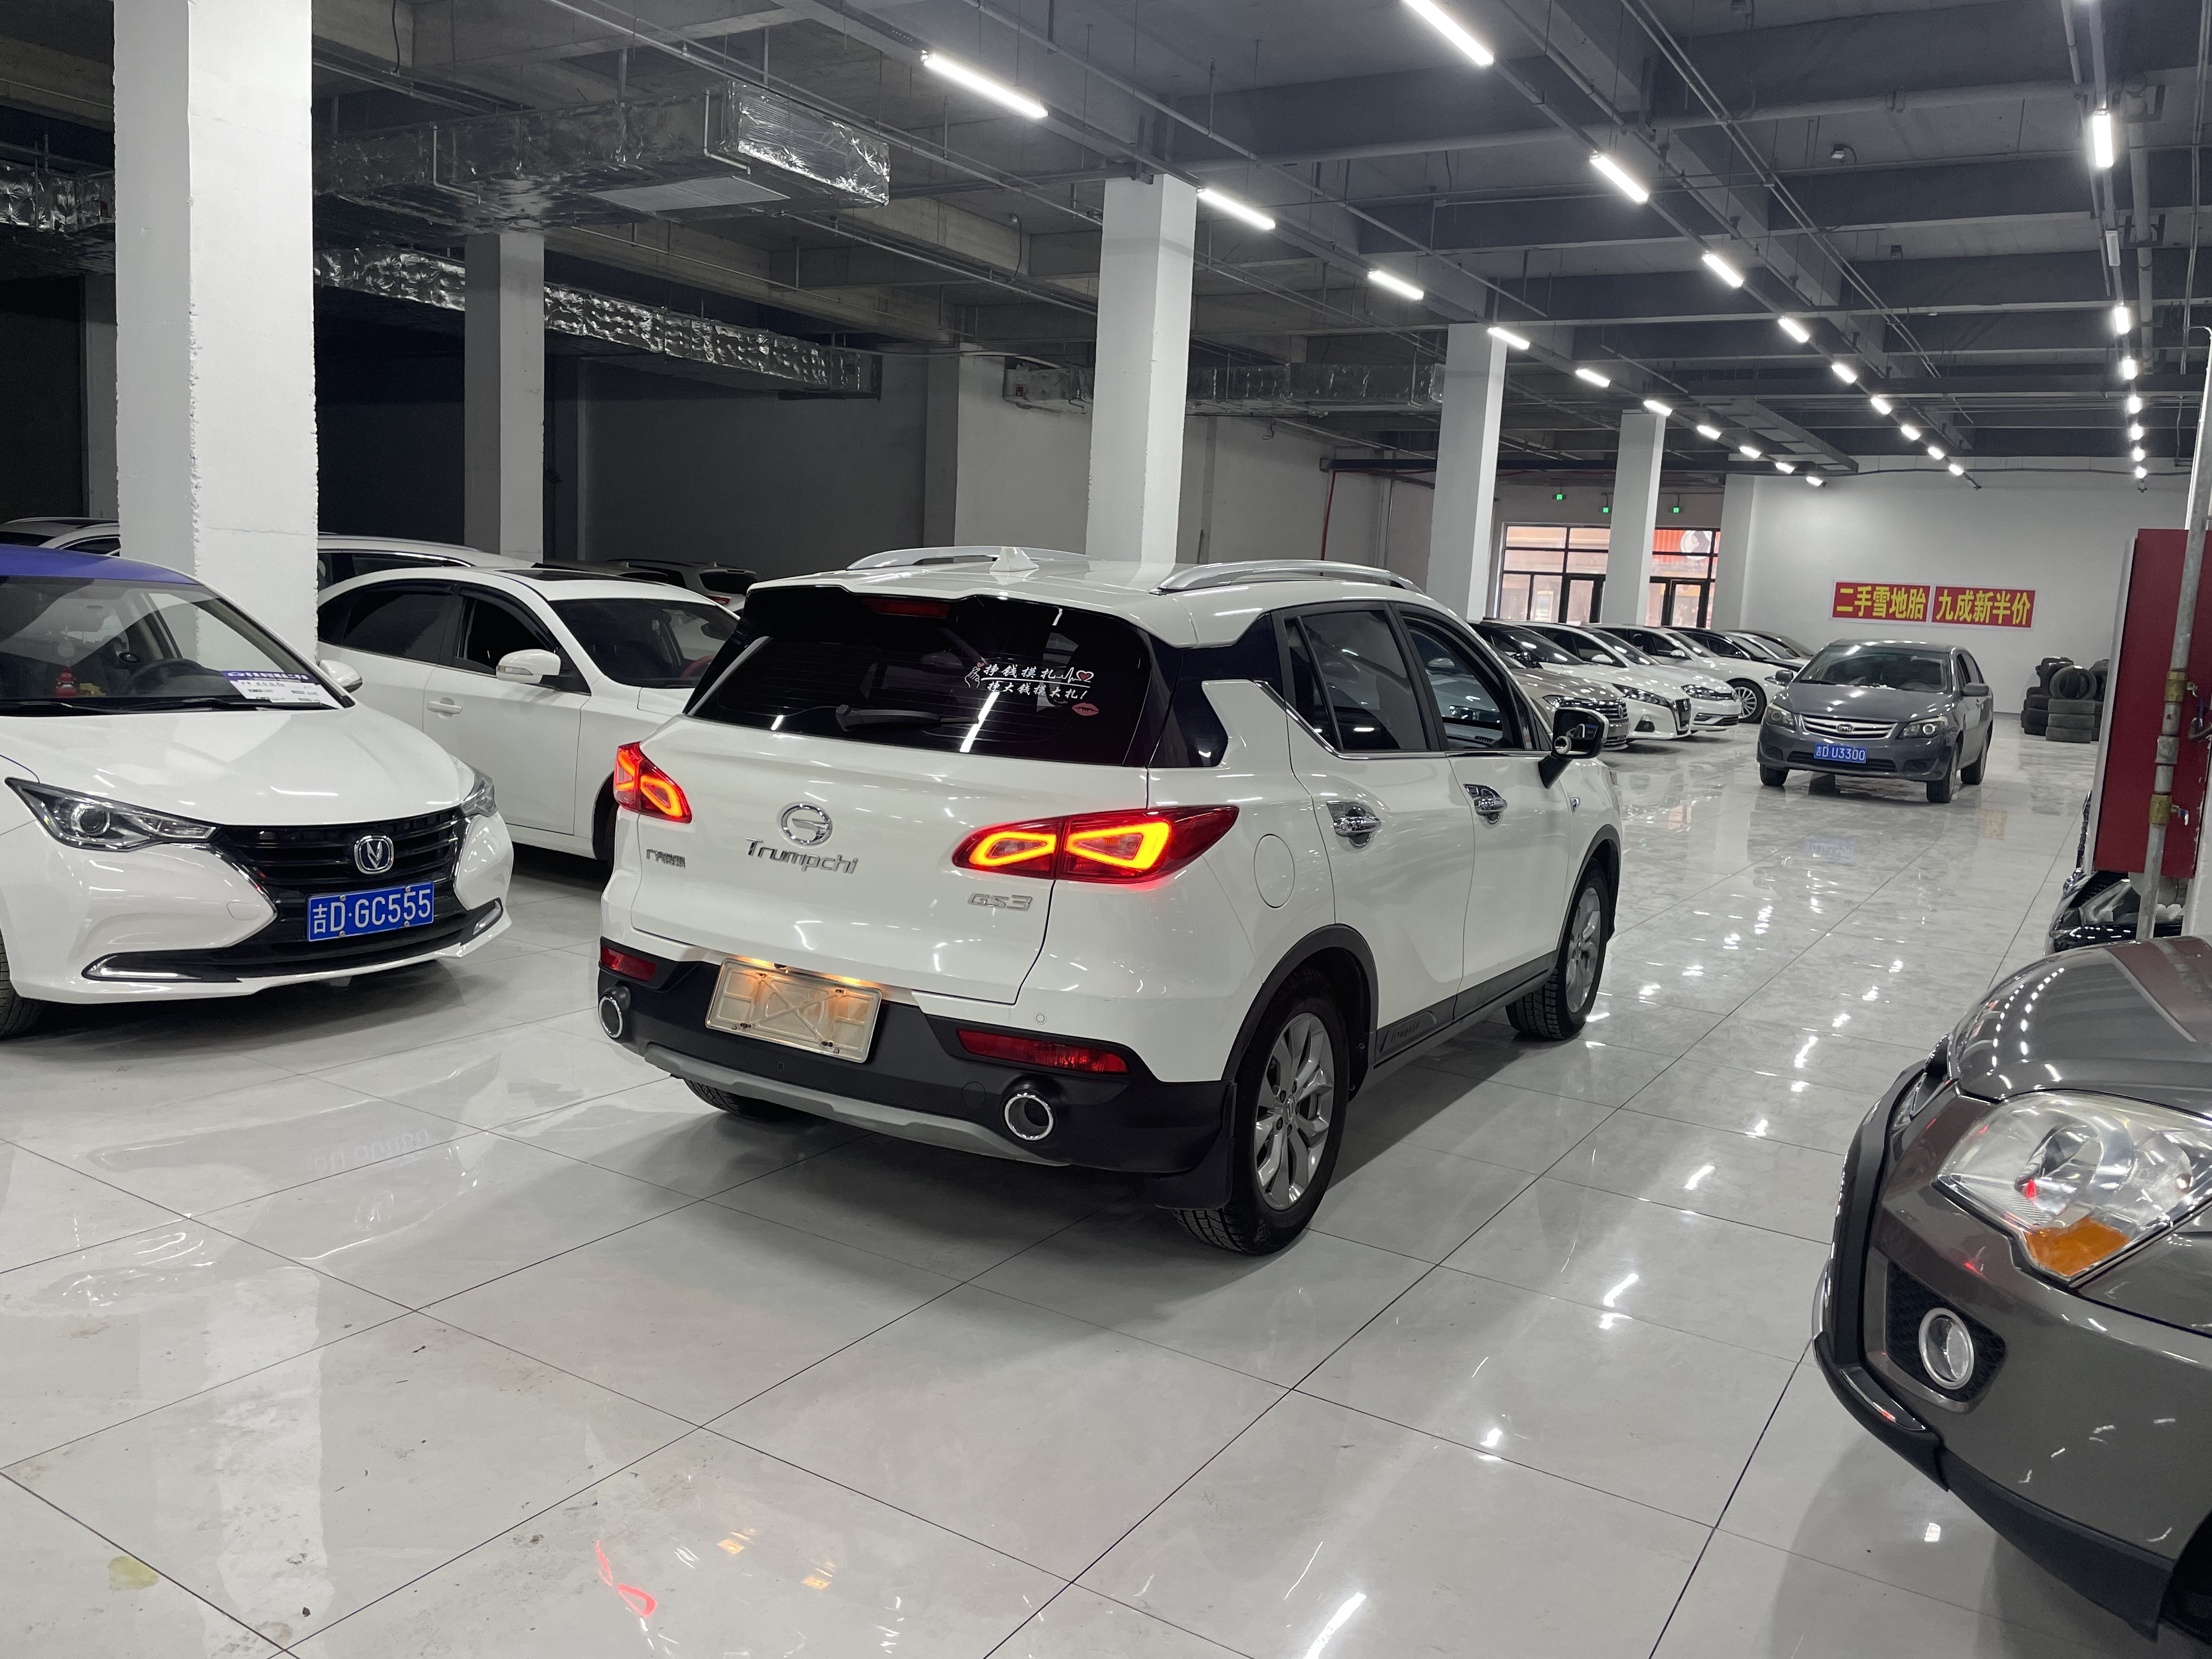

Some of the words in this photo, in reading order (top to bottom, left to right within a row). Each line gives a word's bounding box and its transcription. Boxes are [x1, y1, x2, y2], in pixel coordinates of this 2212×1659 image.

[1836, 585, 1926, 620] 二手雪地胎
[1936, 589, 2031, 625] 九成新半价
[746, 837, 859, 874] Trumpchi
[312, 889, 431, 934] 吉D·GC555
[967, 892, 1033, 912] GS3
